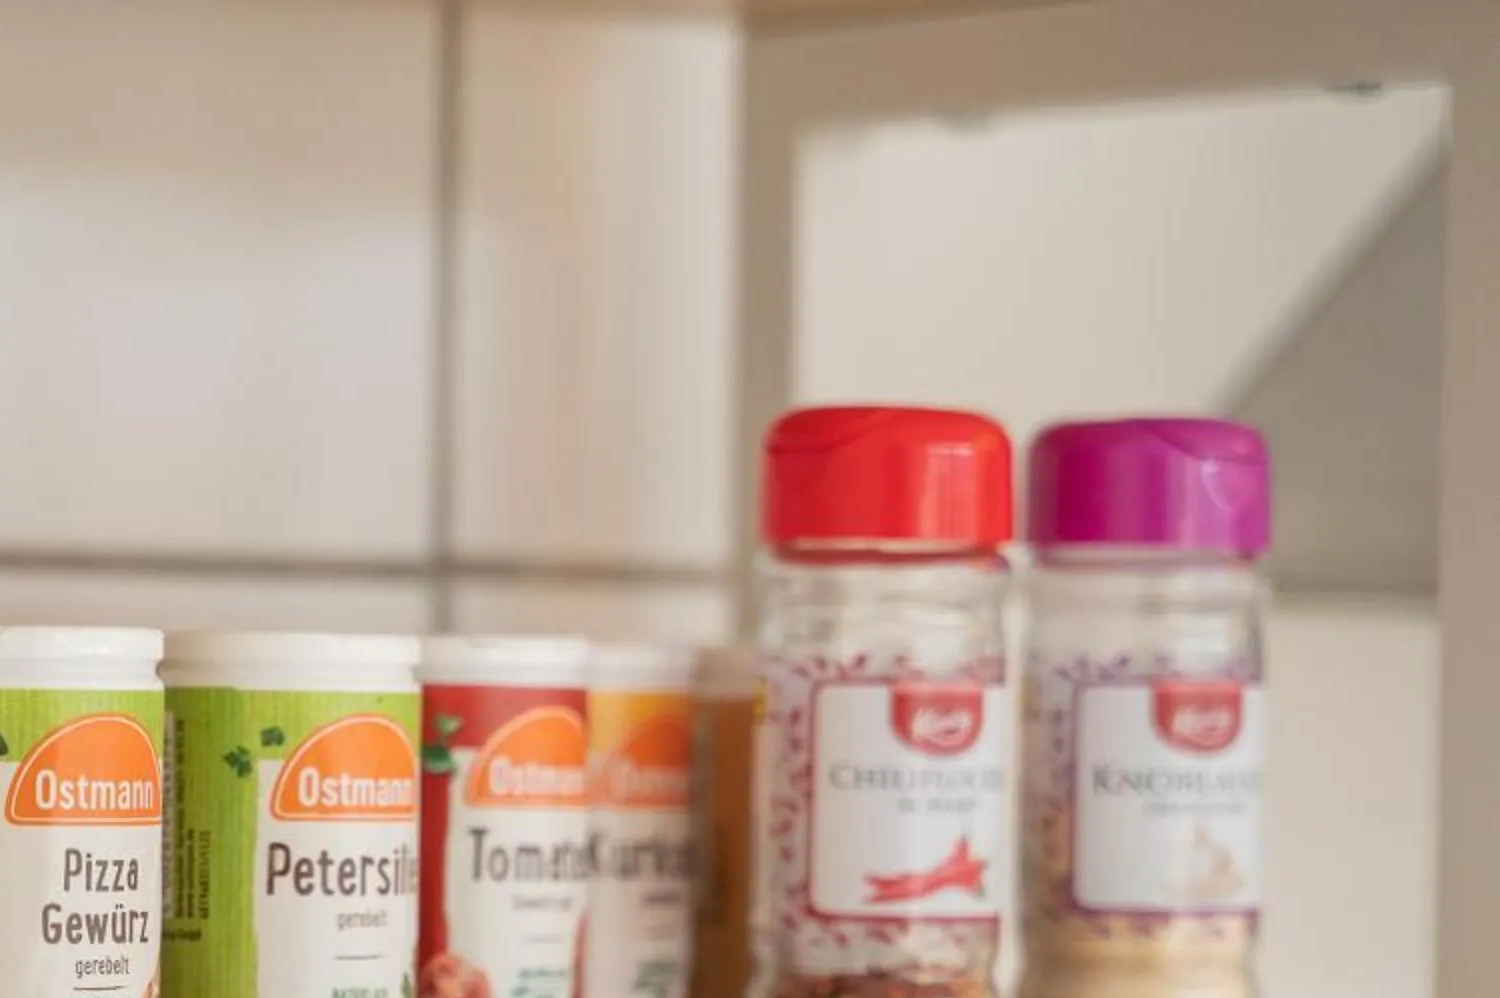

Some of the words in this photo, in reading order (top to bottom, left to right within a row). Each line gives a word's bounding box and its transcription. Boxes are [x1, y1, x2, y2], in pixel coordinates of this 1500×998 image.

[35, 768, 154, 811] Ostmann
[63, 848, 139, 892] Pizza
[41, 902, 149, 945] Gewürz
[74, 953, 131, 979] gerebelt
